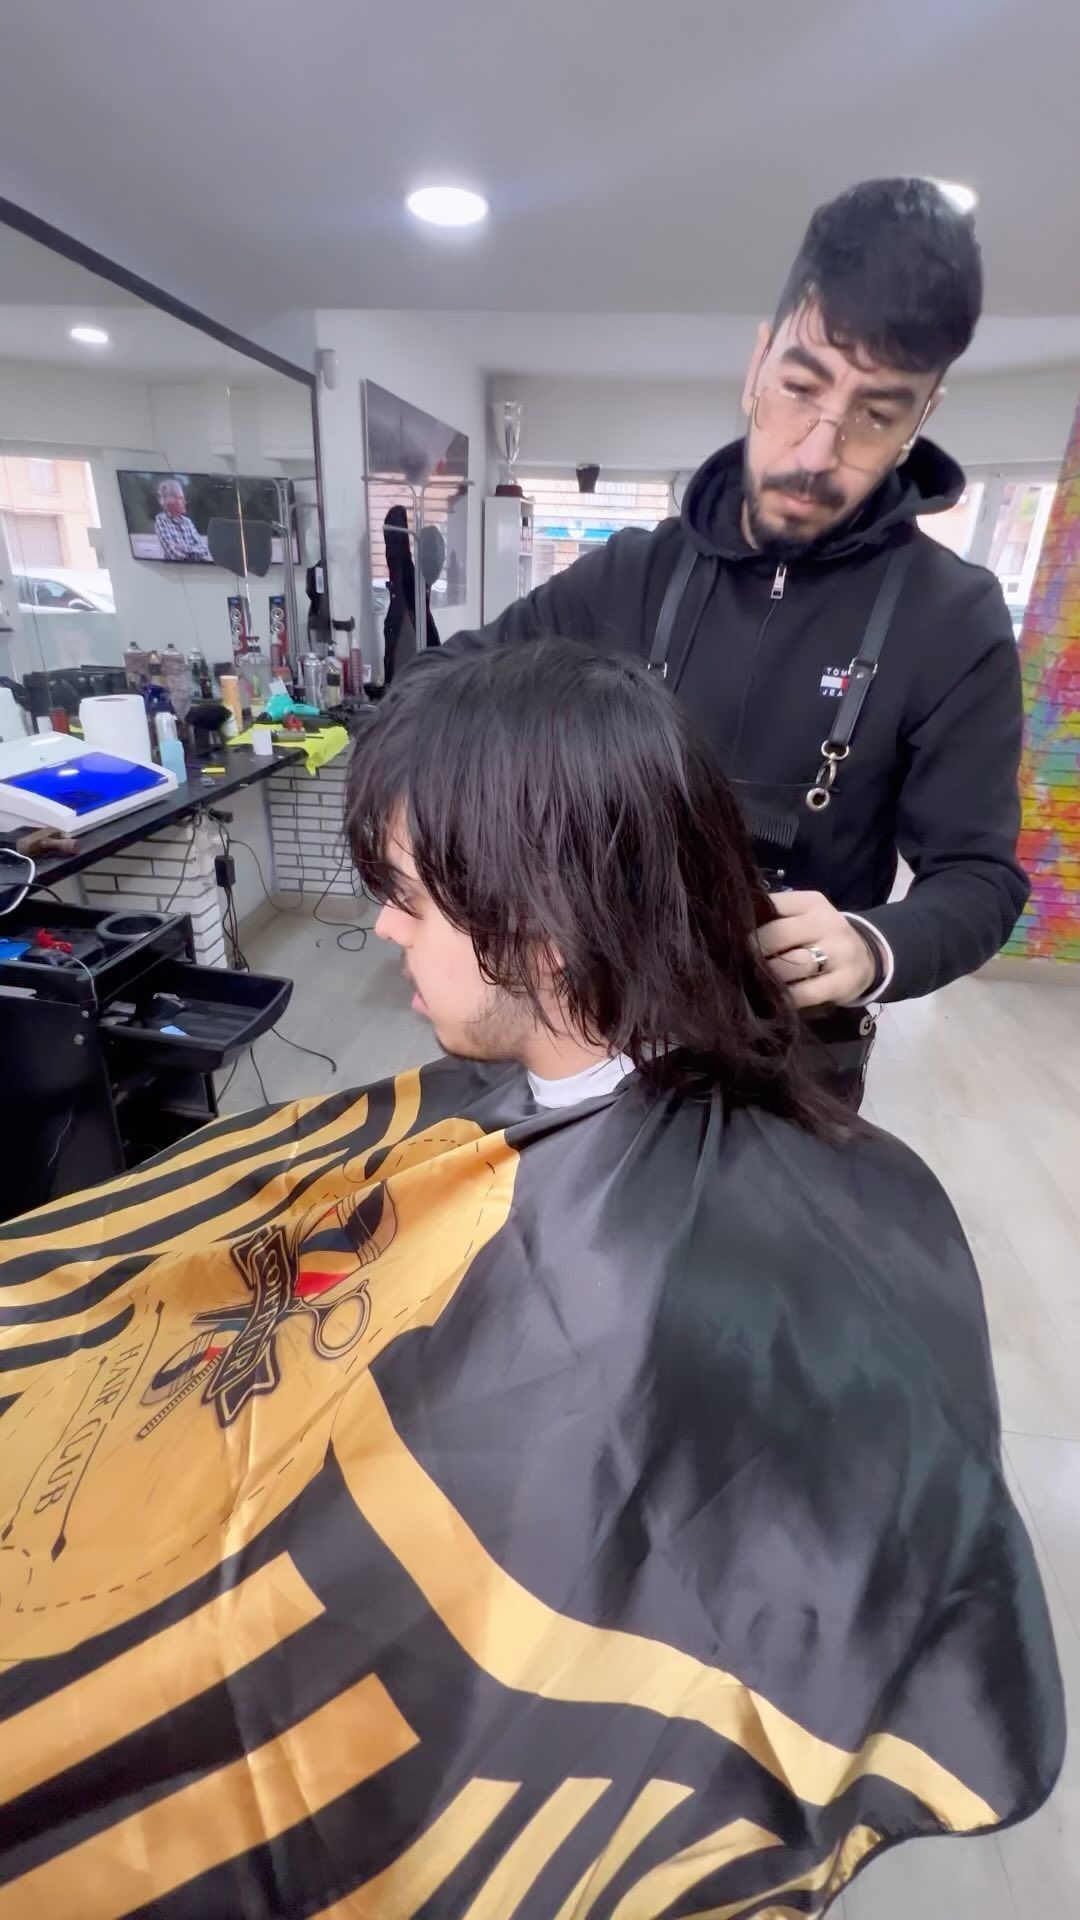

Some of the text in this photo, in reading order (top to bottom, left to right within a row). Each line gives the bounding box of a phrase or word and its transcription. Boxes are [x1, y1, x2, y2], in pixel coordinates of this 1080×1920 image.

[826, 667, 848, 677] TOM
[822, 688, 843, 697] JEA
[33, 1343, 144, 1515] HAIR CLUB
